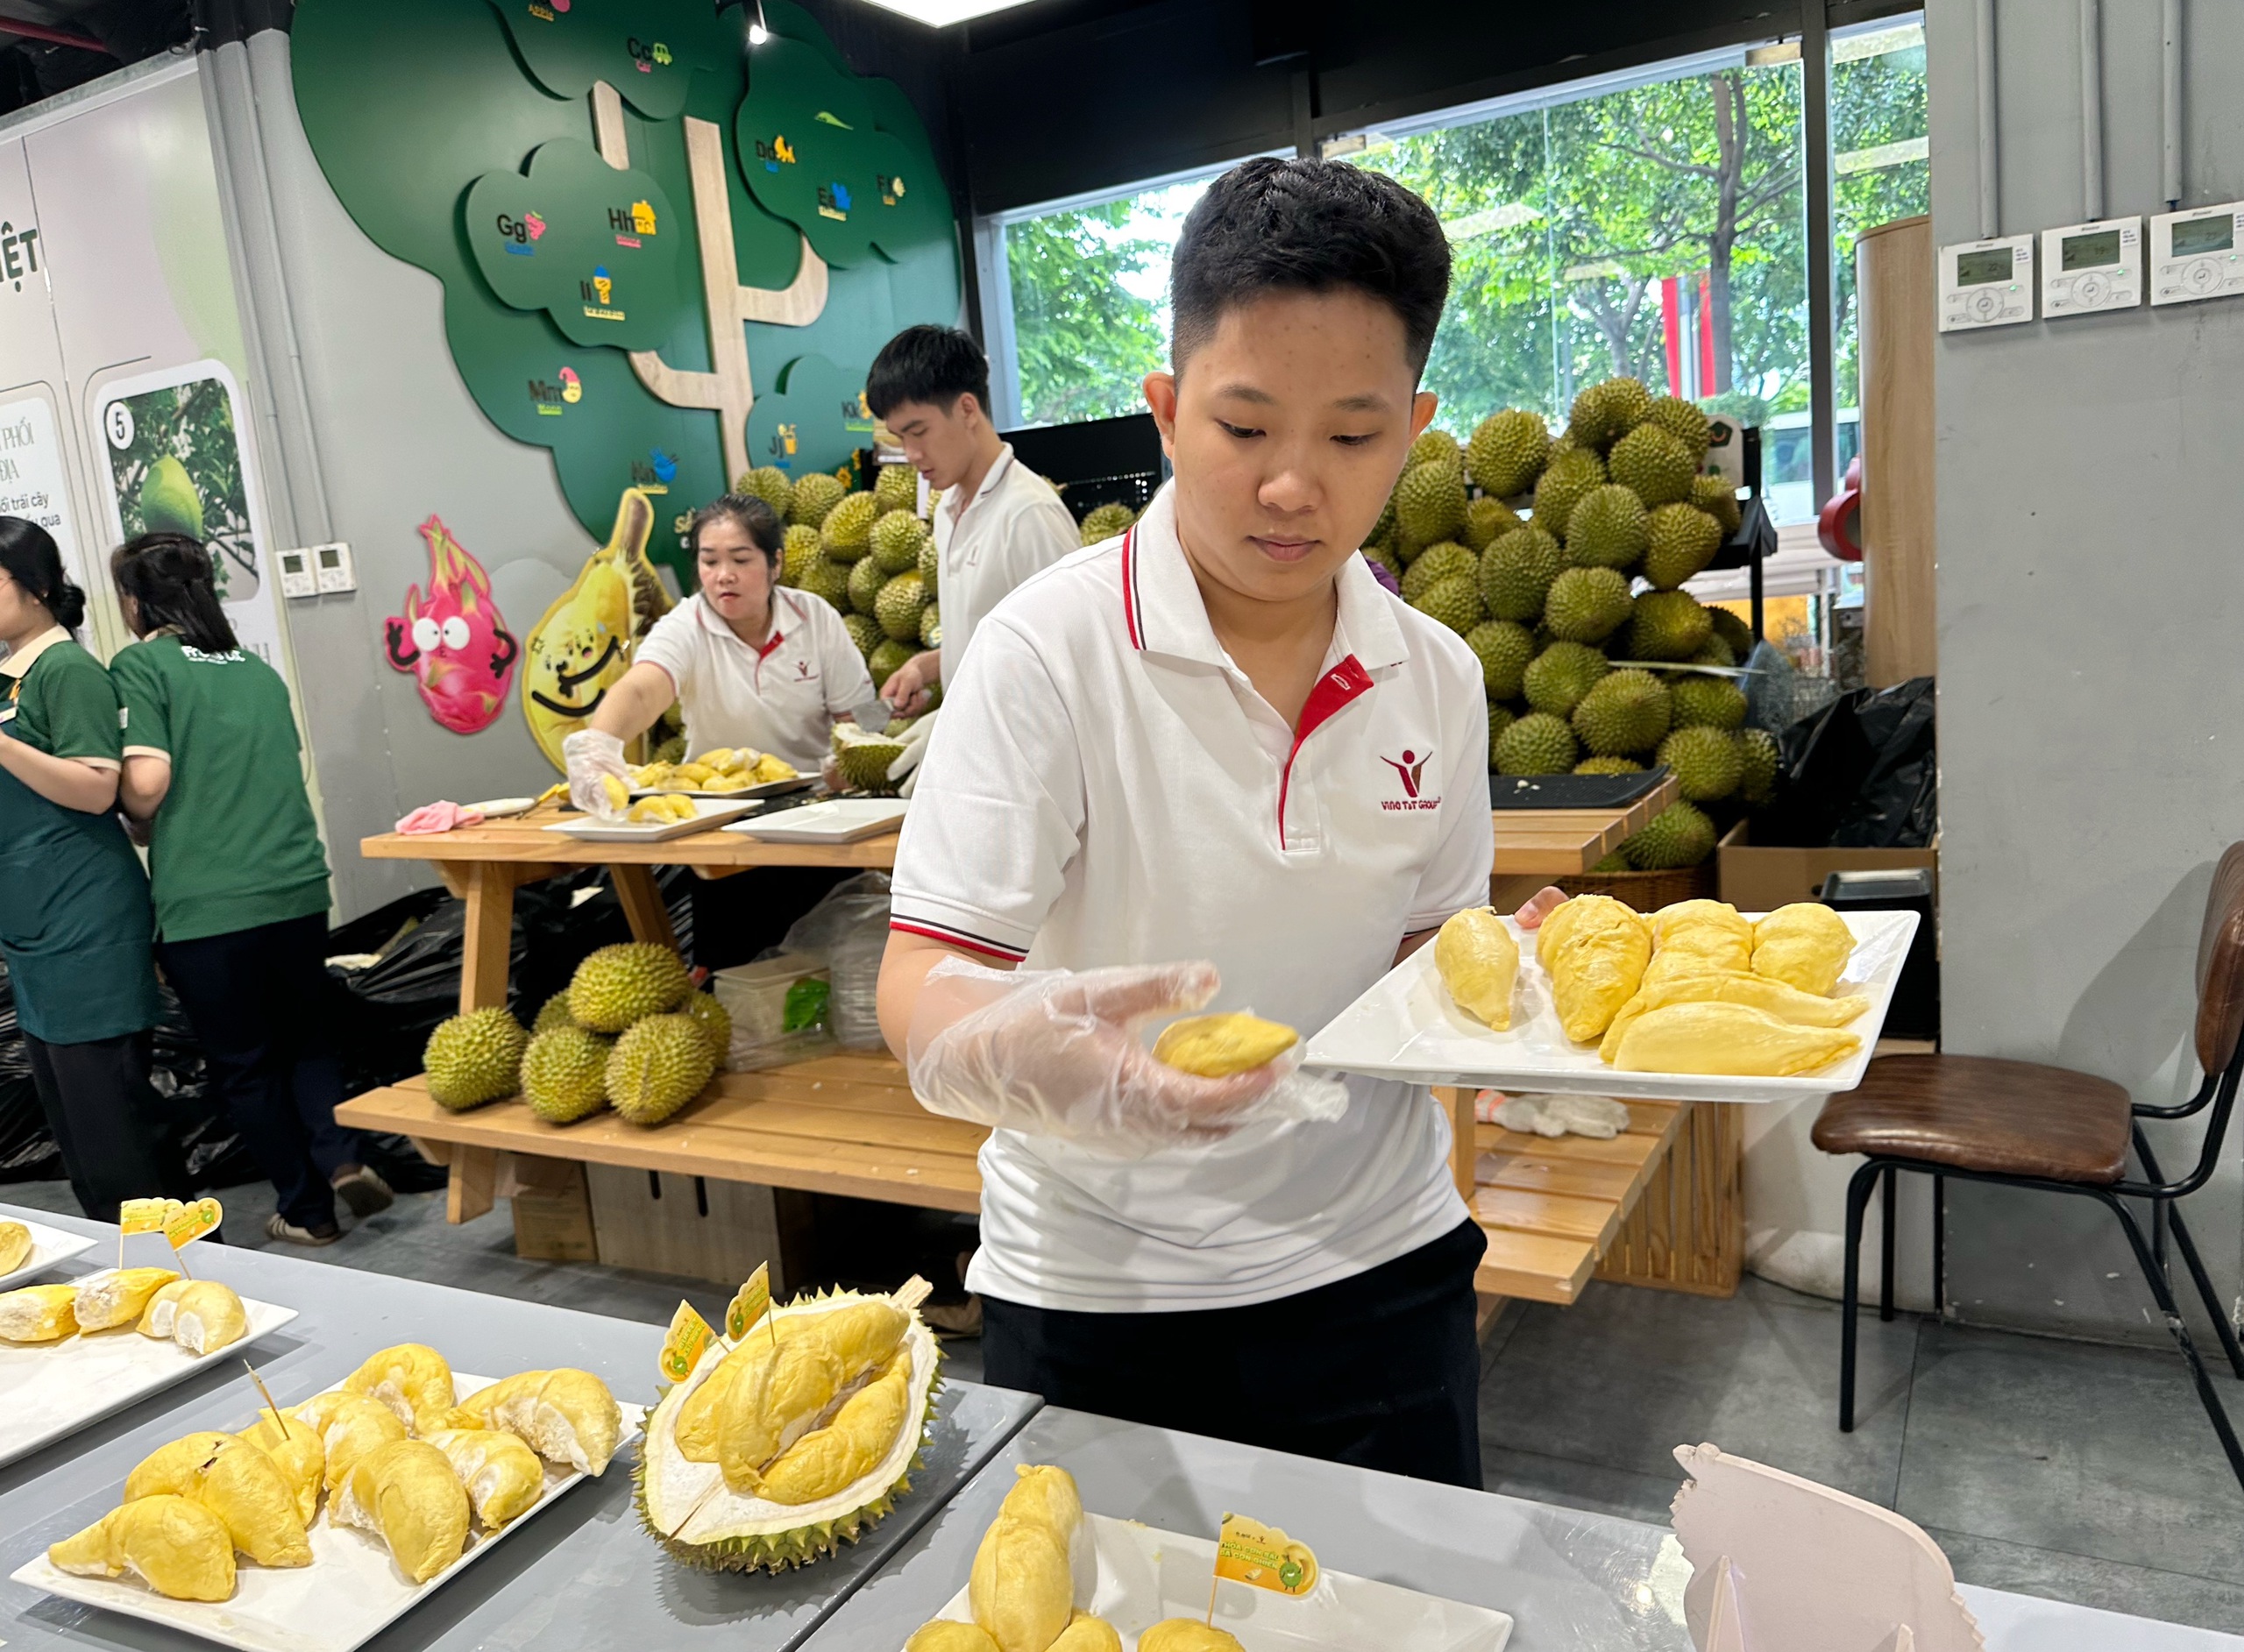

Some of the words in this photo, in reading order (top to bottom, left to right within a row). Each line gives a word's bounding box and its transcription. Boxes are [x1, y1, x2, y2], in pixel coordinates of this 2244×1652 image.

[497, 214, 528, 244] Gg
[607, 208, 636, 232] Hh
[529, 380, 563, 401] Mm
[116, 411, 125, 440] 5
[11, 494, 30, 511] trái
[31, 492, 49, 509] cây
[40, 514, 61, 530] qua
